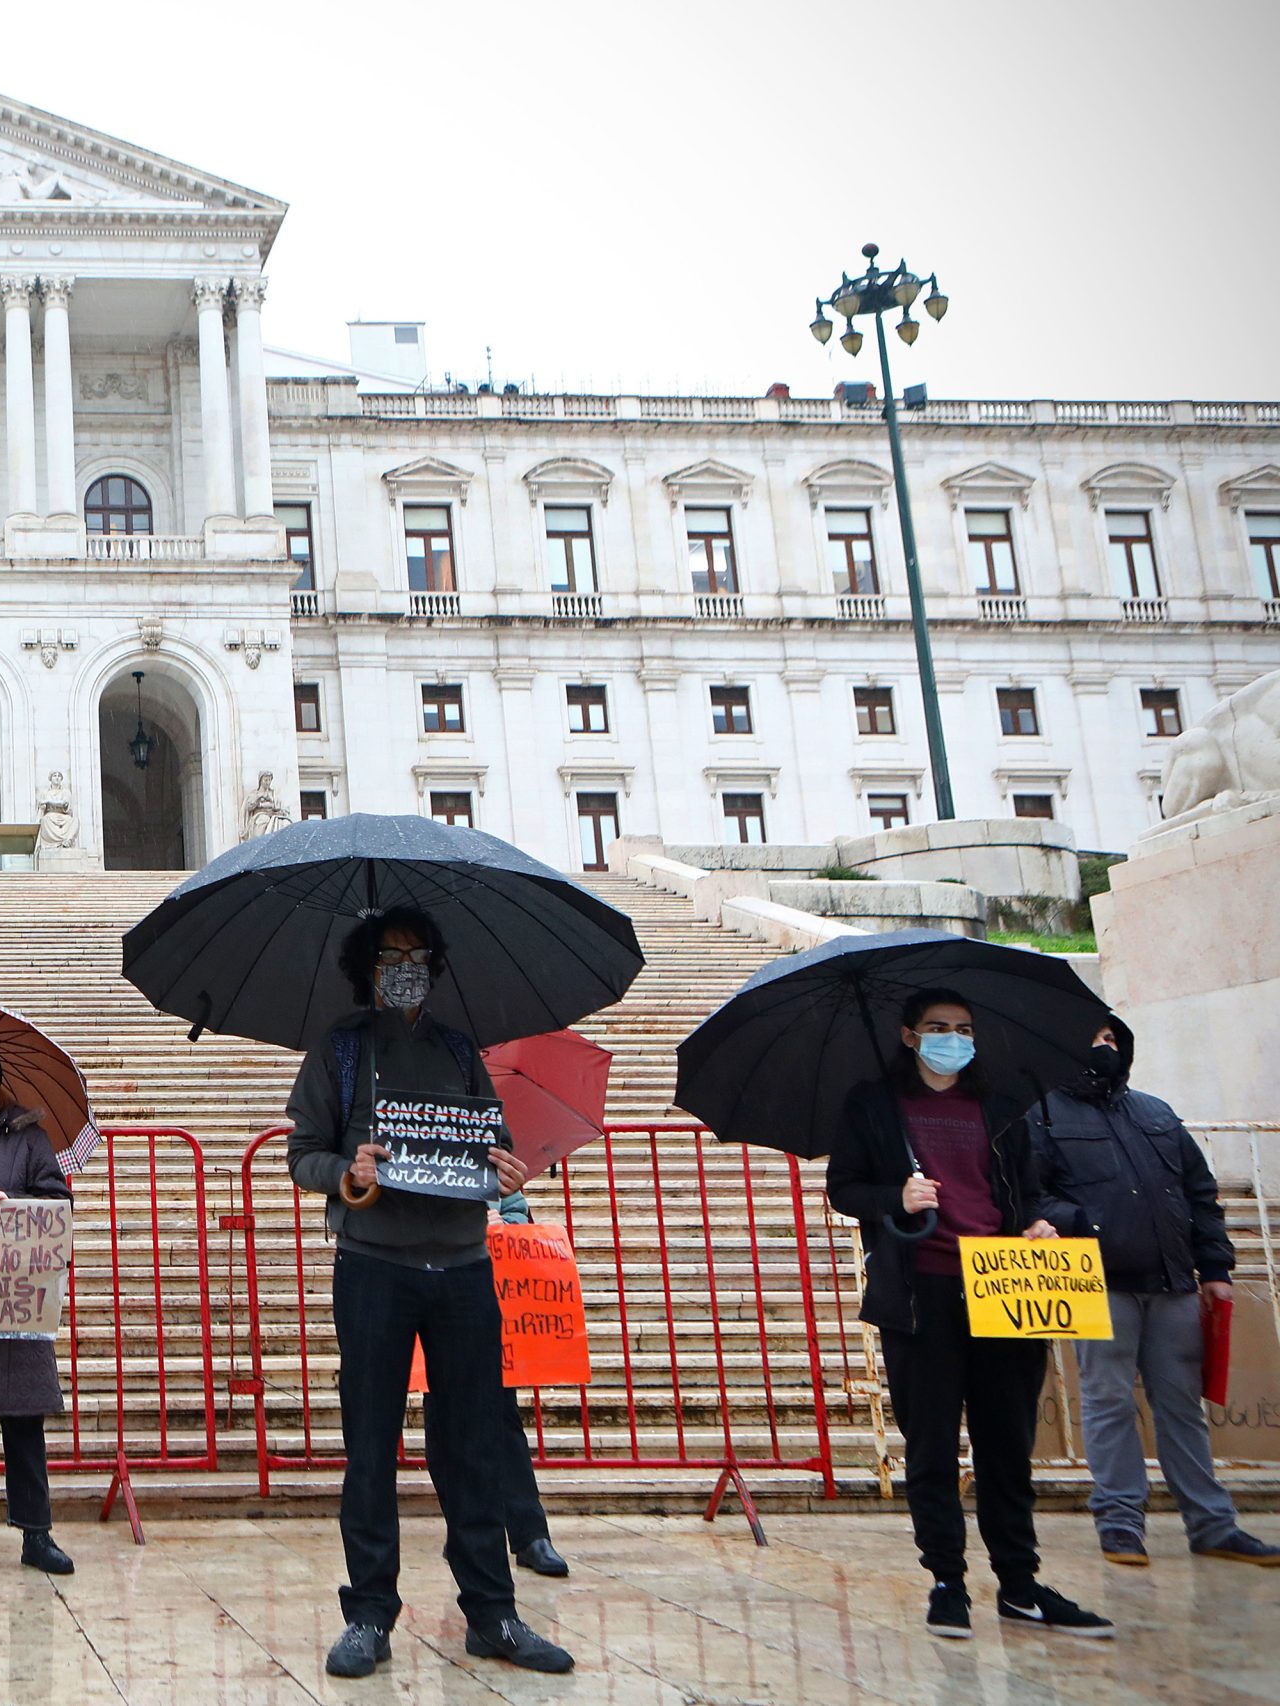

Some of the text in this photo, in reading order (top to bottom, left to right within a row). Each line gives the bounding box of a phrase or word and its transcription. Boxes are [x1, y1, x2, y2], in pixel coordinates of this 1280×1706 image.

[376, 1120, 497, 1145] MONOPOLISTA
[28, 1243, 66, 1277] NOS
[971, 1248, 1093, 1275] QUEREMOS O
[973, 1274, 1105, 1299] CINEMA PORTUGUÊS
[1001, 1298, 1073, 1331] VIVO
